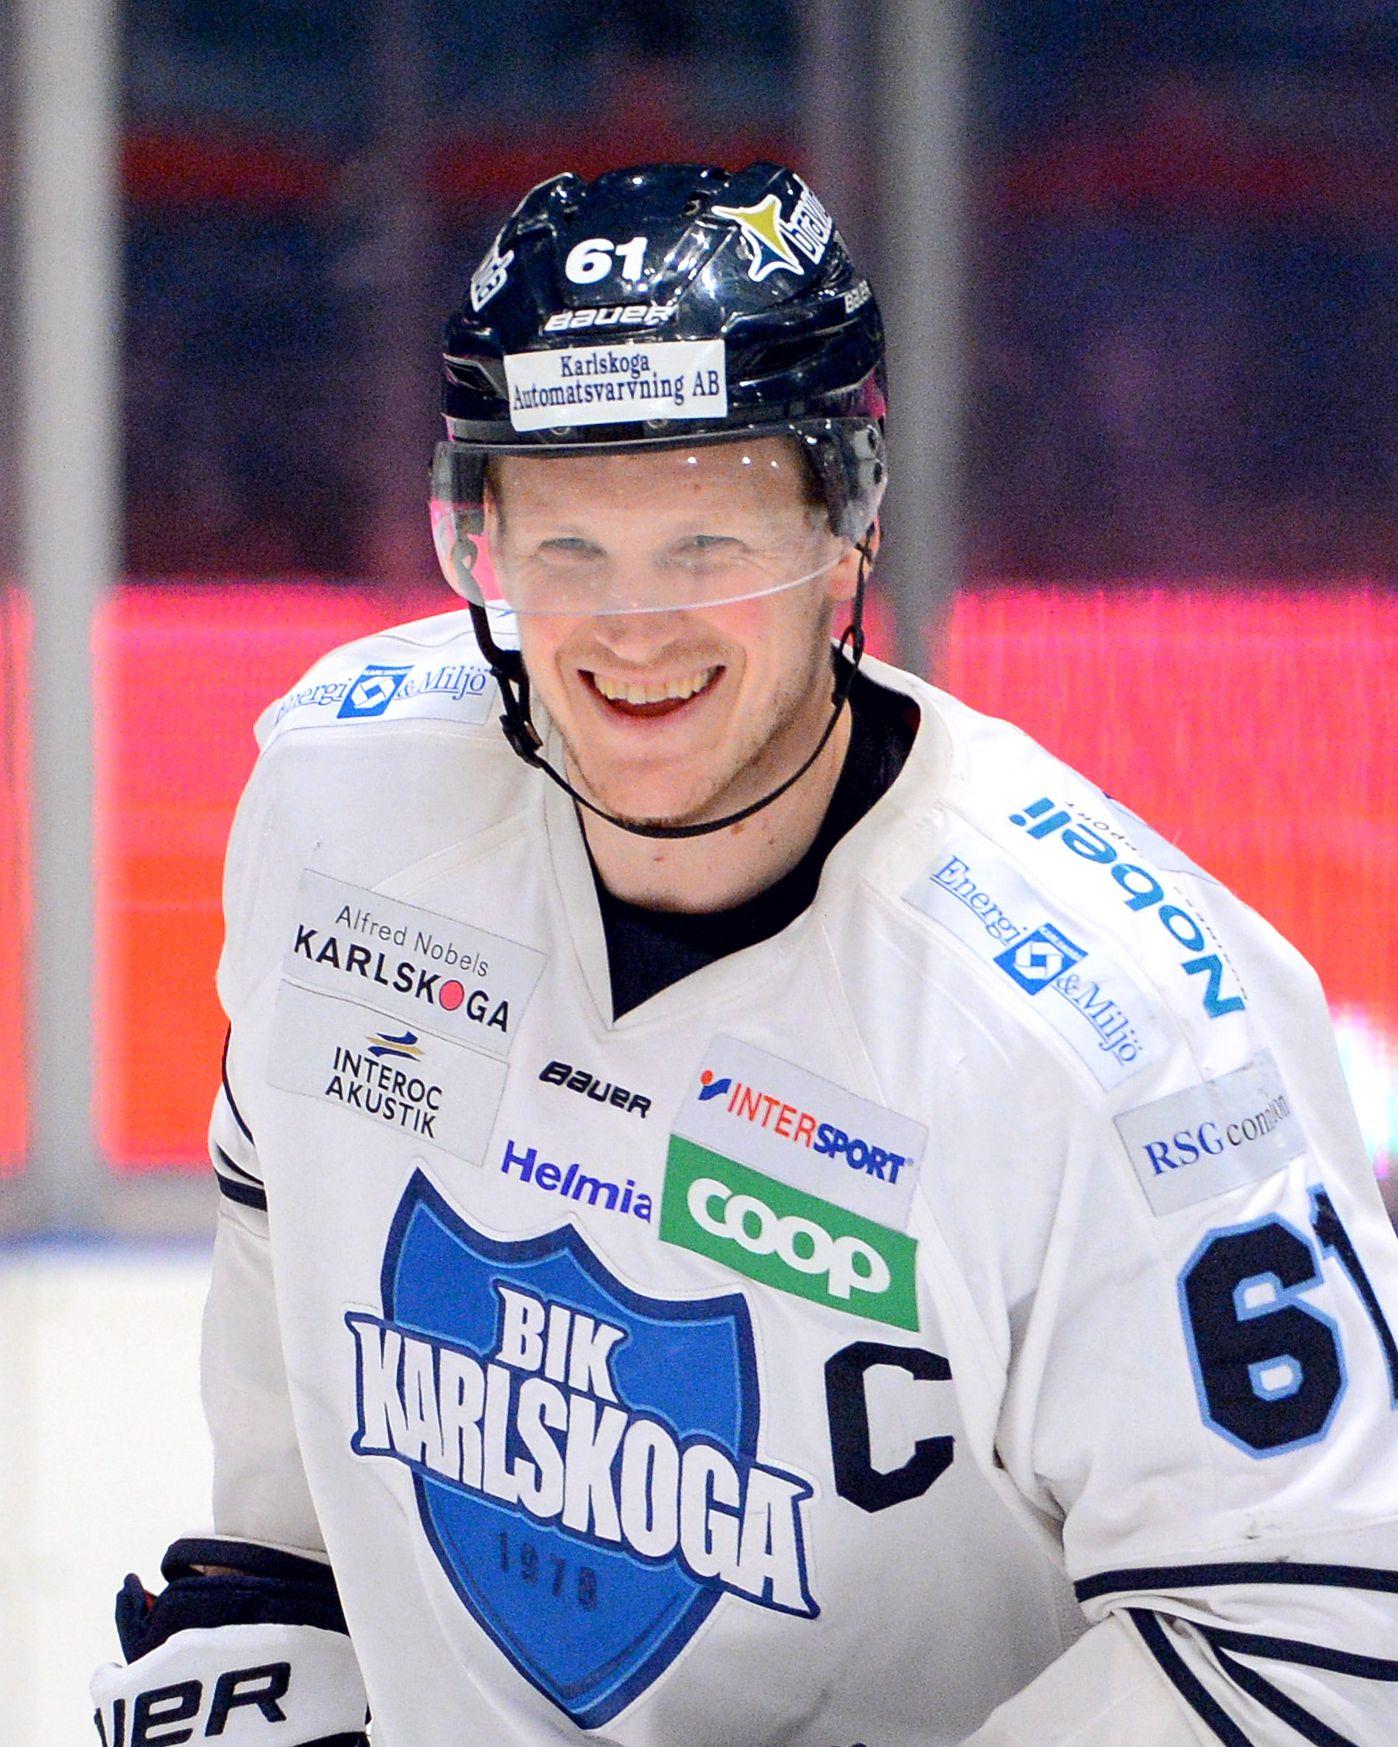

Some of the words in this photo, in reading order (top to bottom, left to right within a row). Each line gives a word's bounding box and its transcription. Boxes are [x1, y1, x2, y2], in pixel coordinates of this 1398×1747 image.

[565, 238, 648, 284] 61
[544, 304, 676, 333] BAUER
[513, 373, 685, 410] Automatsvarvning
[692, 370, 720, 397] AB
[560, 352, 650, 379] Karlskoga
[930, 855, 1029, 948] Energi
[1008, 796, 1246, 1019] Nobeli
[293, 923, 510, 1033] KARLSKOGA
[336, 905, 407, 946] Alfred
[414, 931, 489, 978] Nobels
[325, 1075, 436, 1139] AKUSTIK
[332, 1046, 443, 1111] INTEROC
[539, 1060, 652, 1119] BAUER
[727, 1081, 908, 1185] INTERSPORT
[1143, 1121, 1224, 1175] RSG
[501, 1139, 652, 1224] Helmia
[687, 1177, 892, 1300] coop
[494, 1286, 627, 1400] BIK
[824, 1340, 955, 1514] C
[350, 1319, 818, 1617] KARLSKOGA
